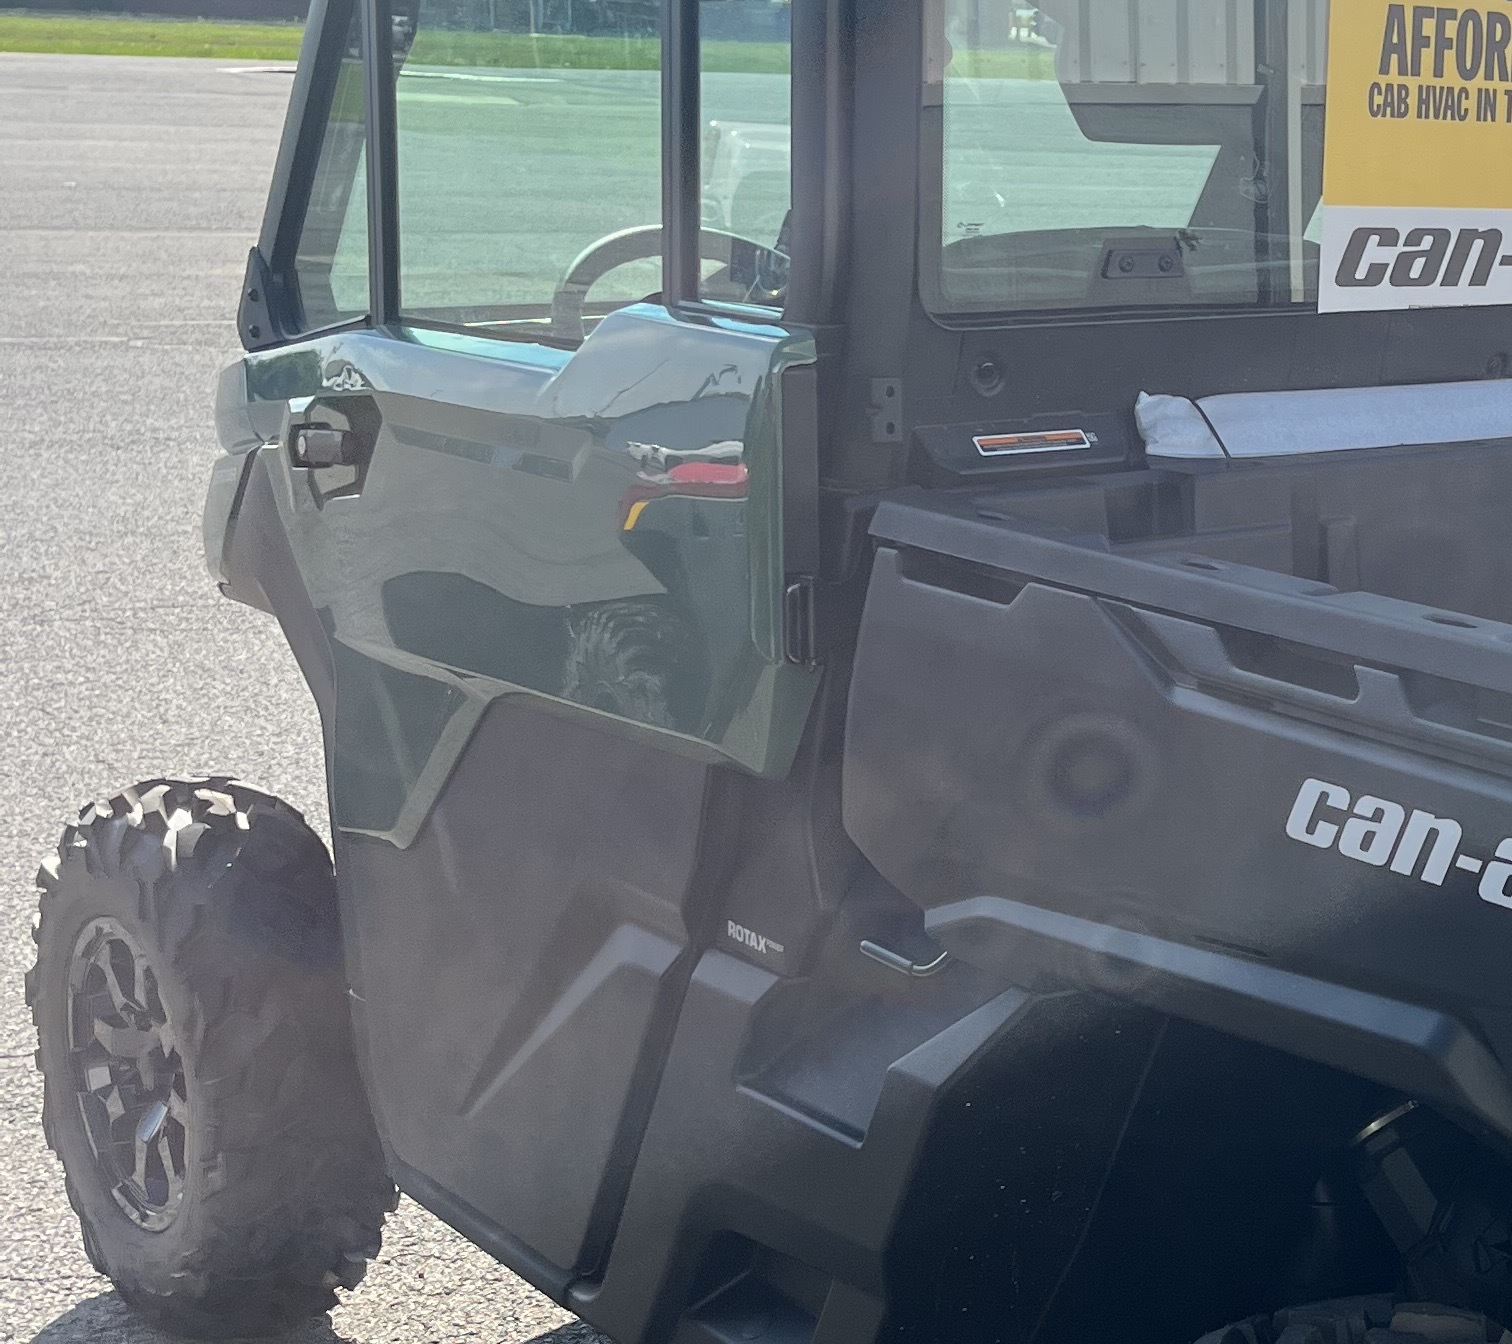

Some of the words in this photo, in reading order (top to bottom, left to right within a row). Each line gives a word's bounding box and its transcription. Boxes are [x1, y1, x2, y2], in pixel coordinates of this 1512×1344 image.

[1368, 82, 1409, 118] CAB
[1416, 84, 1470, 121] HVAC
[1476, 88, 1497, 122] IN
[727, 919, 767, 954] ROTAX
